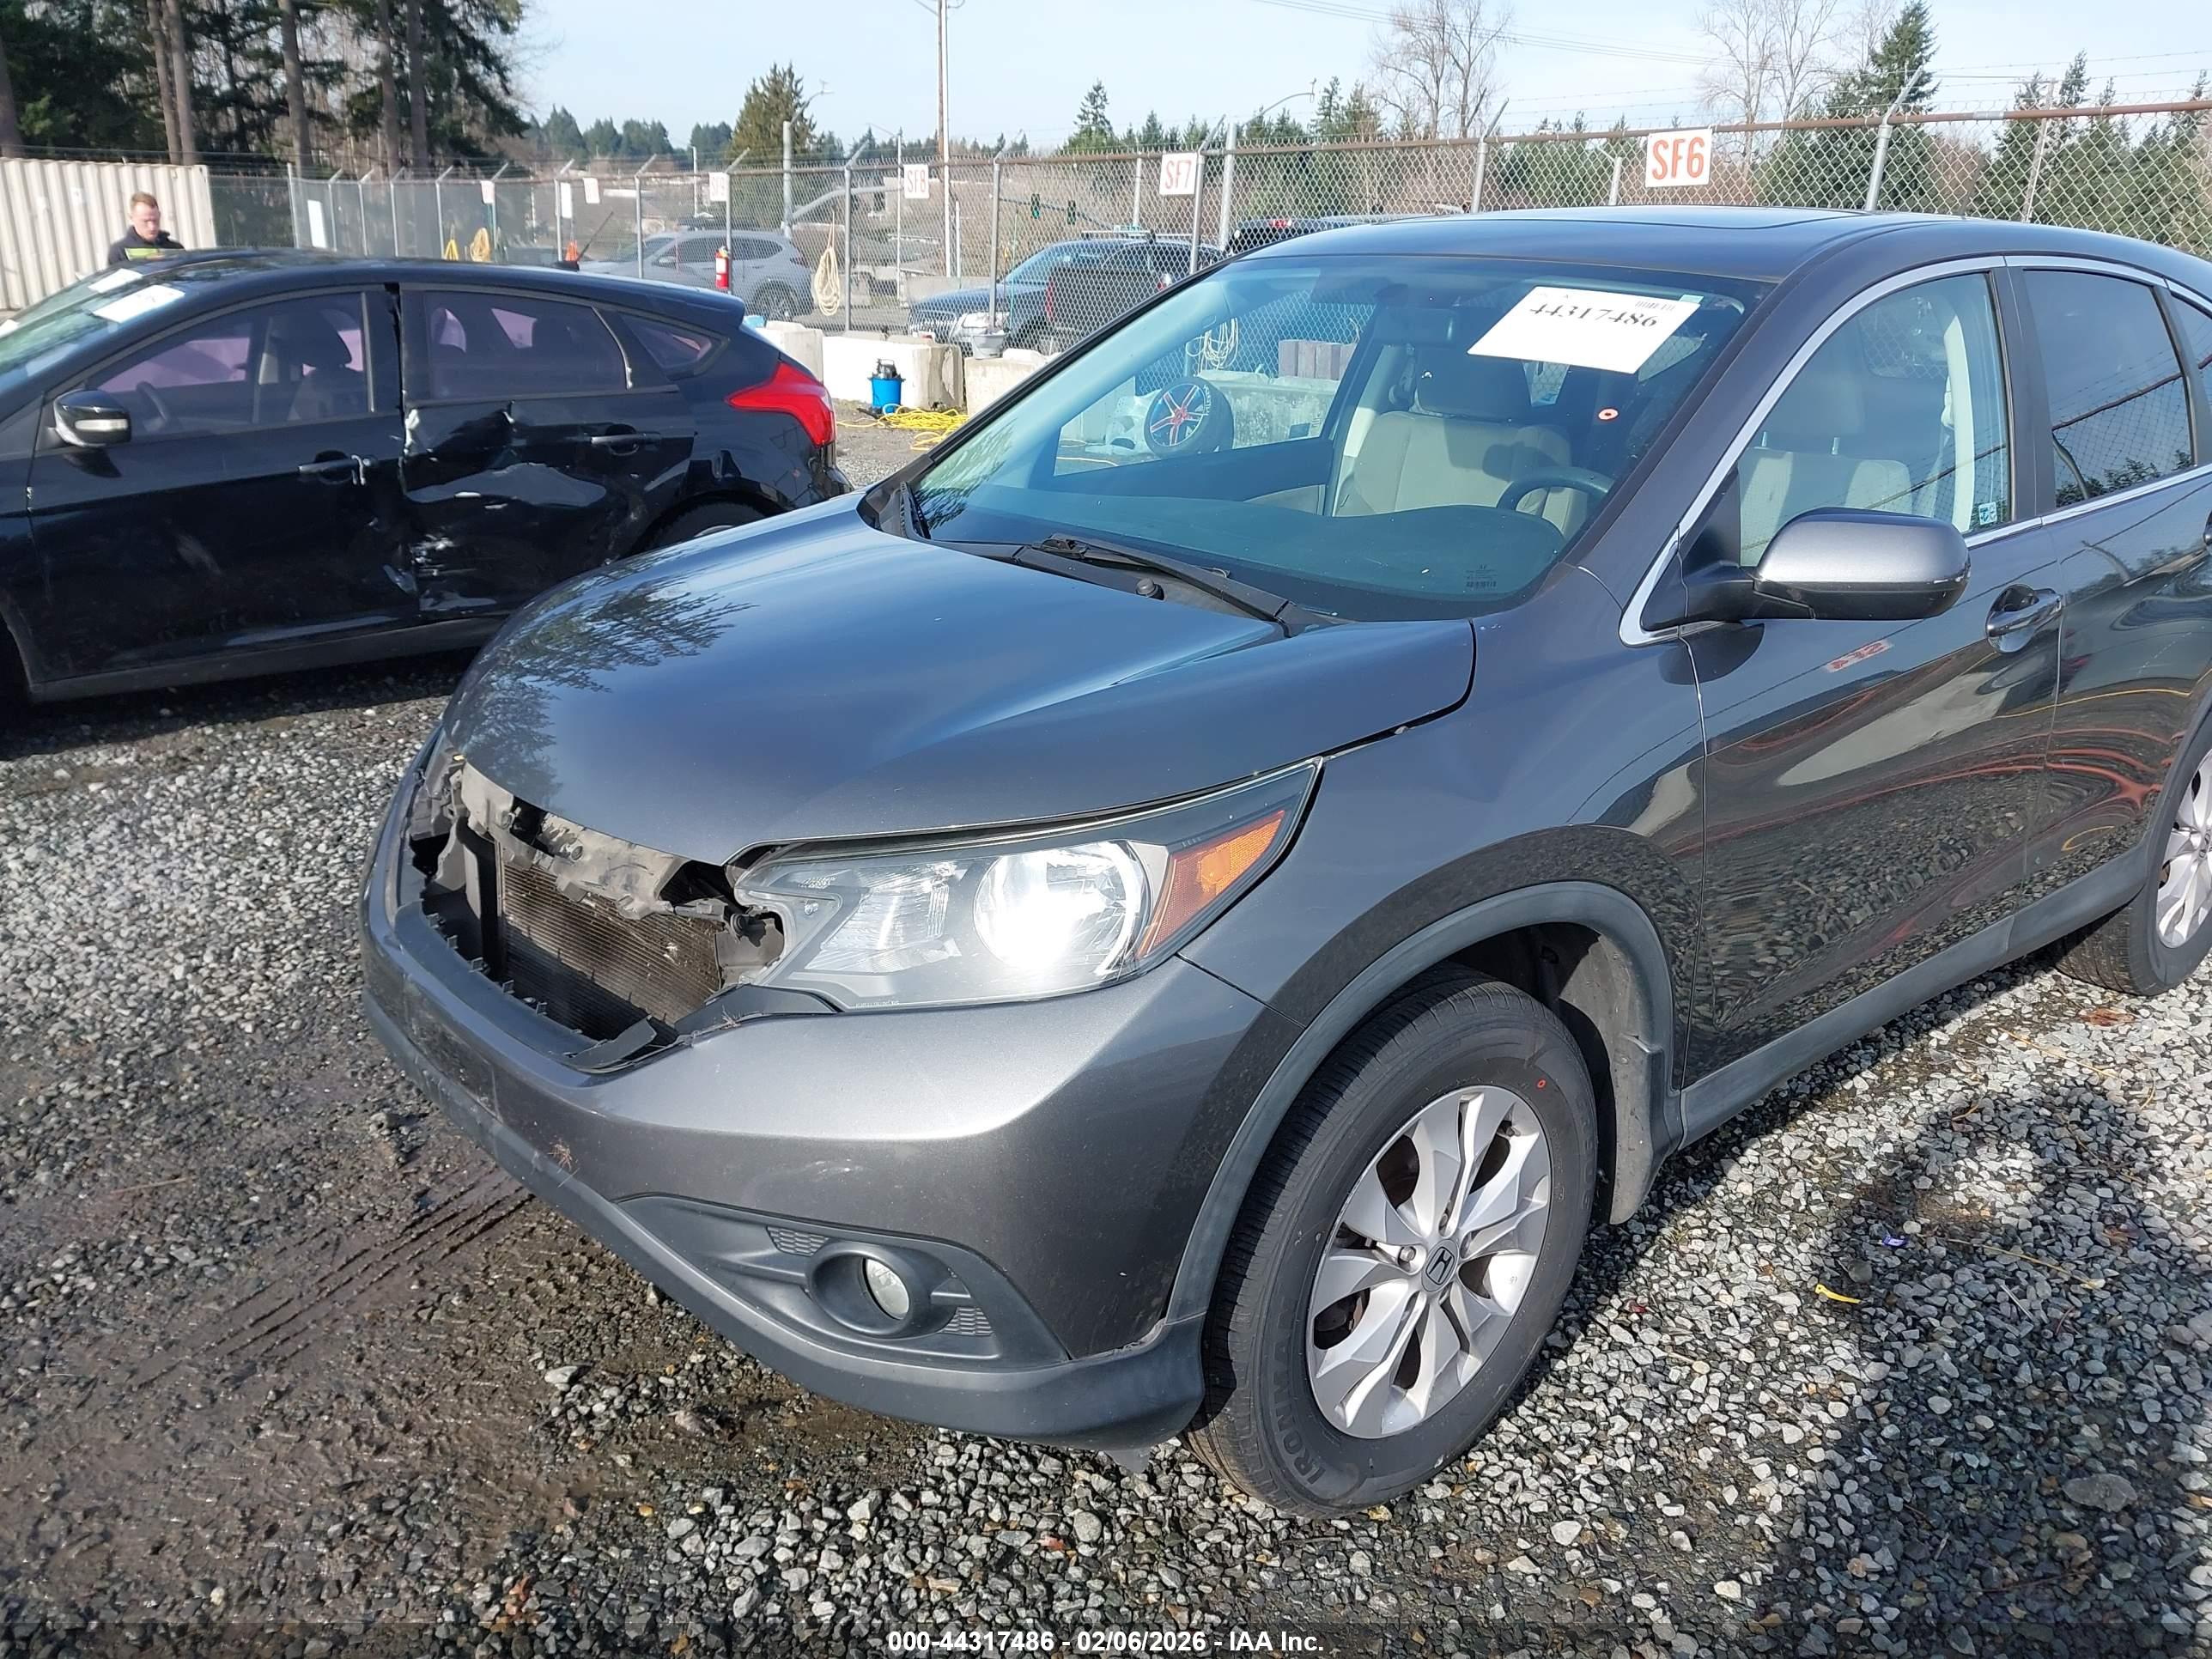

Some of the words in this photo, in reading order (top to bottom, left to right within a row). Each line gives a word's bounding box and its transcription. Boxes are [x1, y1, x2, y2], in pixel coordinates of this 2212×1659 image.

[1651, 137, 1705, 179] SF6
[1165, 160, 1192, 189] SF7
[1528, 302, 1658, 327] 44317486
